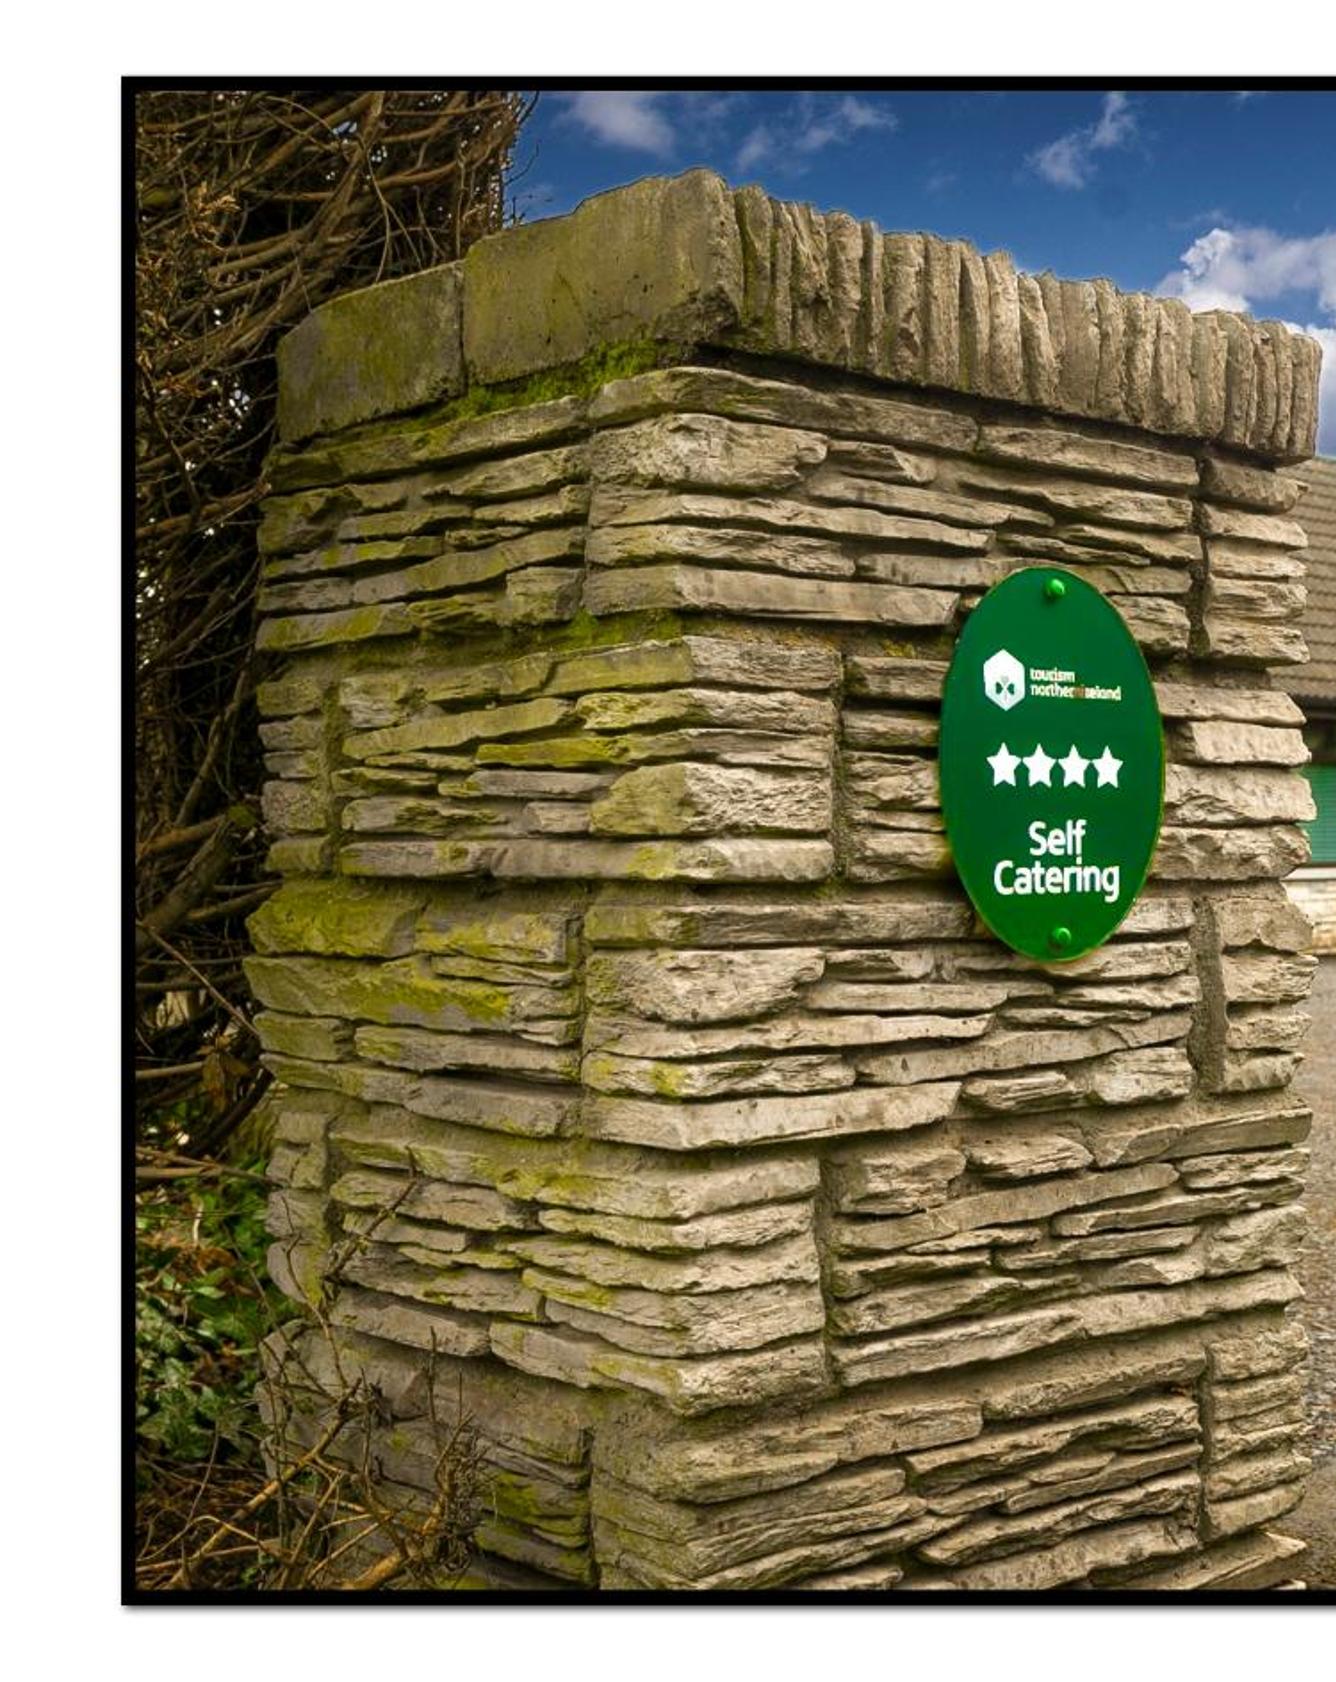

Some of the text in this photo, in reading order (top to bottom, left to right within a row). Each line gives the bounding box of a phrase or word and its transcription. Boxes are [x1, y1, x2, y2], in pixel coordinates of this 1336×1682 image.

[1030, 667, 1075, 682] tourism
[1028, 819, 1087, 856] Self
[993, 857, 1120, 903] Catering
